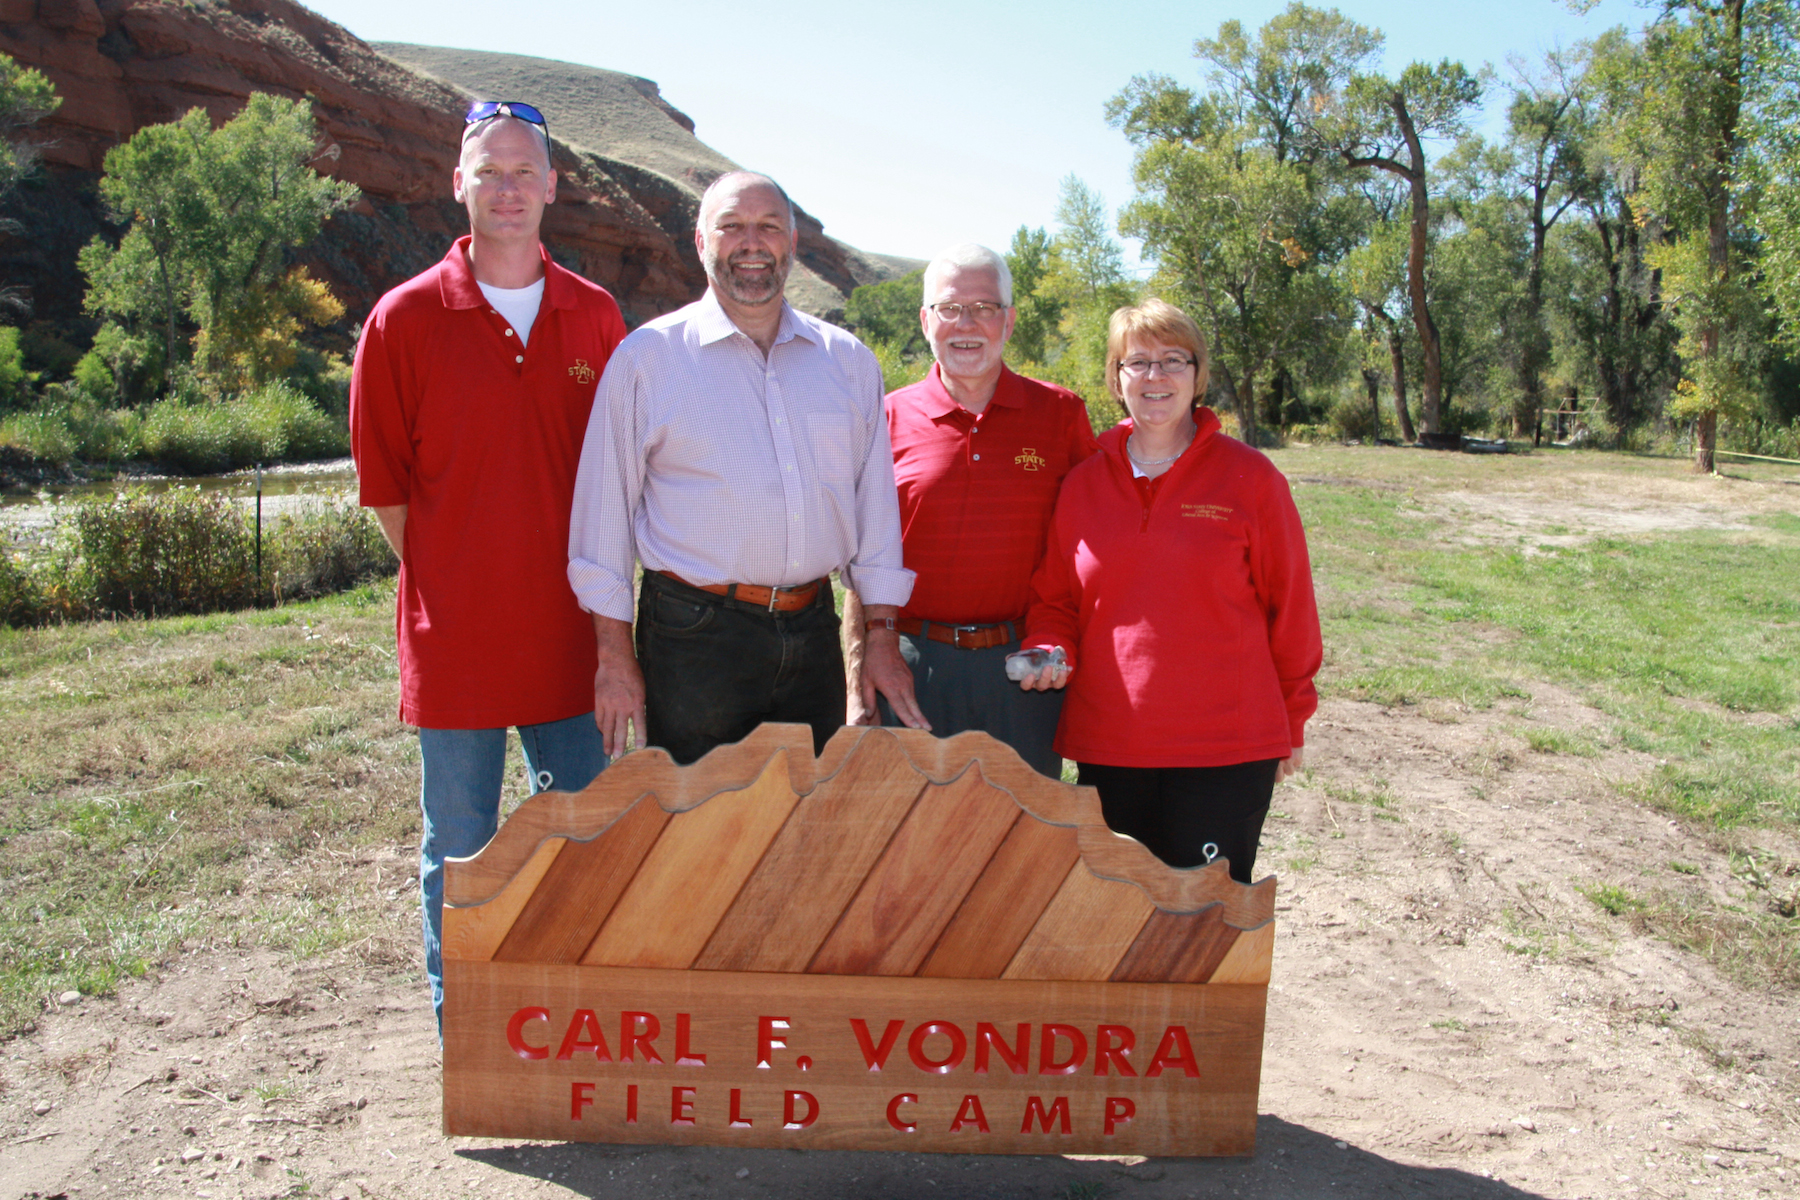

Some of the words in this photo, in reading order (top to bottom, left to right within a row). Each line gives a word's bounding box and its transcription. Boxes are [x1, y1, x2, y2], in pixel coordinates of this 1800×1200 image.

[568, 366, 596, 380] STATE
[1014, 454, 1046, 467] STATE
[506, 1006, 706, 1066] CARL
[756, 1016, 813, 1071] F.
[849, 1018, 1201, 1078] VONDRA
[570, 1082, 820, 1130] FIELD
[885, 1092, 1136, 1135] CAMP
